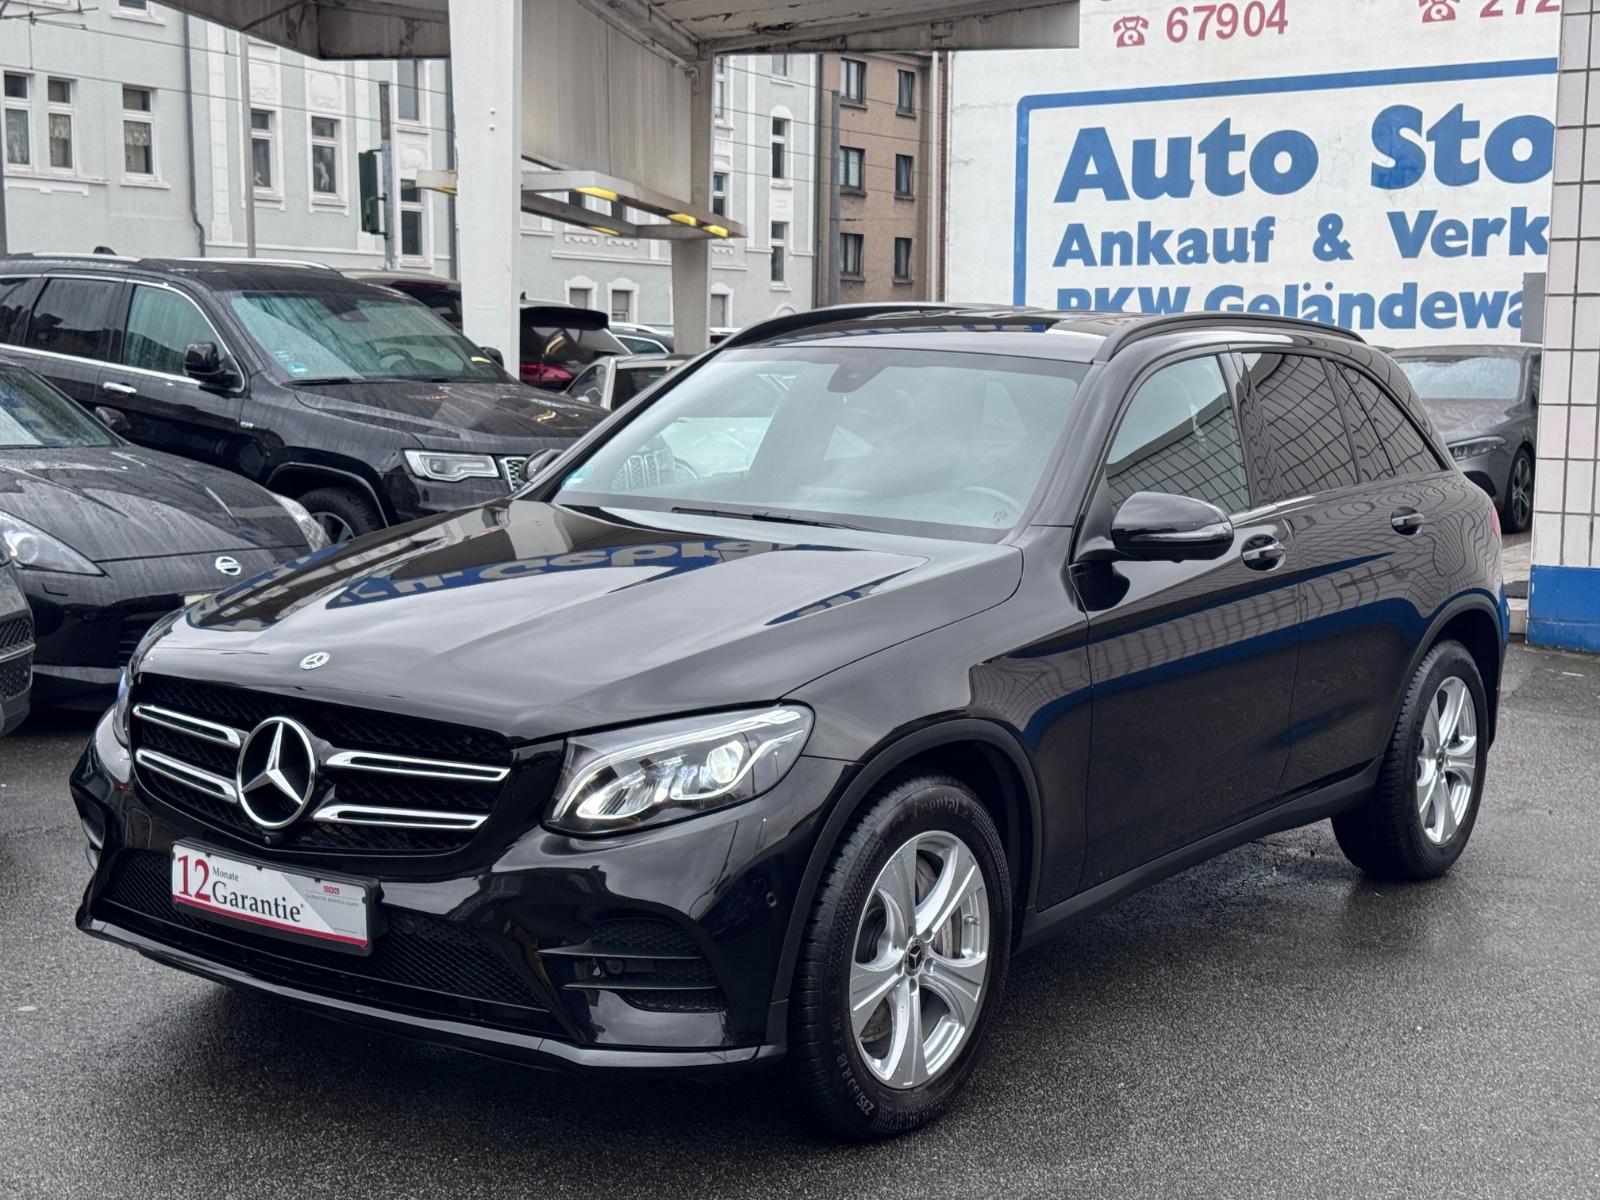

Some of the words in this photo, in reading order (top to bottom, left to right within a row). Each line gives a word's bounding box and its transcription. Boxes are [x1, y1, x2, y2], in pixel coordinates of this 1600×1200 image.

[1166, 0, 1288, 43] 67904
[1053, 117, 1319, 204] Auto
[1370, 103, 1555, 190] Sto
[1053, 216, 1275, 267] Ankauf
[1313, 213, 1353, 262] &
[1387, 206, 1549, 258] Verk
[1057, 285, 1190, 313] PKW
[177, 854, 212, 903] 12
[212, 866, 240, 882] Monate
